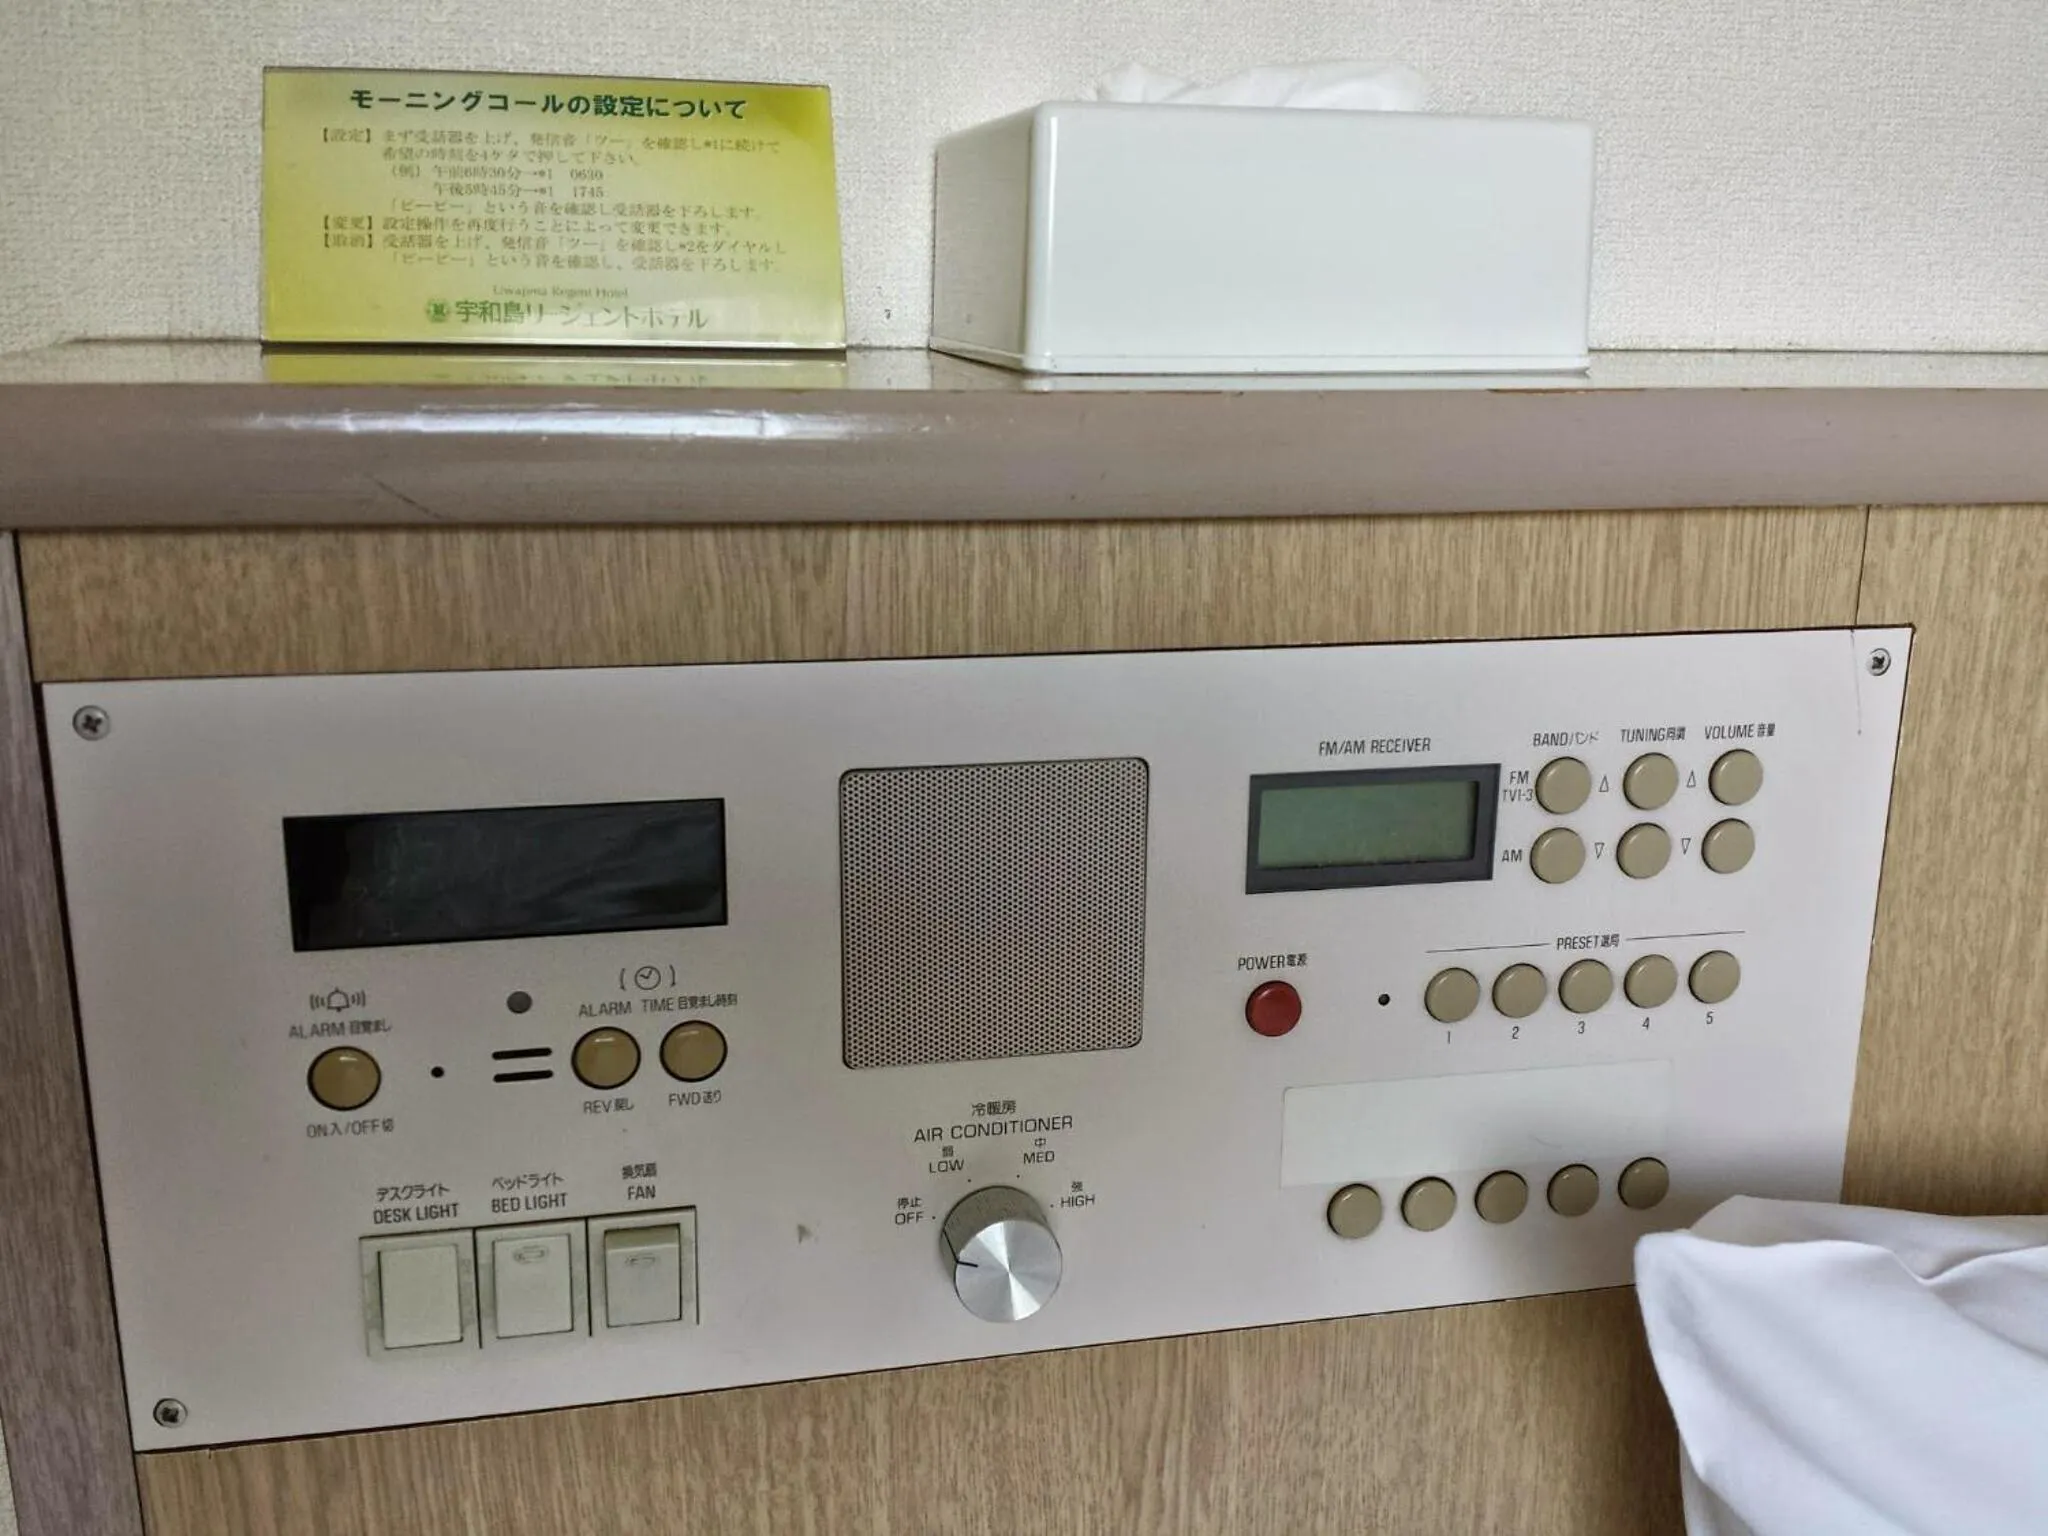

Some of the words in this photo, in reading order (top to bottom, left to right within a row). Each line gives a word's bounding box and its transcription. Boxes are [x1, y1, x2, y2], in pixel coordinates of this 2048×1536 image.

[350, 89, 747, 119] モーニングコールの設定について
[1704, 723, 1754, 740] VOLUME
[1319, 739, 1365, 757] FM/AM
[1370, 737, 1431, 754] RECEIVER
[1509, 770, 1529, 785] FM
[1501, 849, 1522, 863] AM
[578, 1000, 632, 1018] ALARM
[641, 996, 674, 1013] TIME
[1641, 1016, 1650, 1030] 4
[1705, 1011, 1714, 1025] 5
[288, 1021, 346, 1040] ALARM
[1511, 1026, 1520, 1040] 2
[1577, 1021, 1585, 1034] 3
[971, 1100, 1017, 1117] 冷暖房
[914, 1127, 943, 1143] AIR
[951, 1115, 1073, 1140] CONDITIONER
[1023, 1150, 1055, 1164] MED
[928, 1159, 964, 1174] LOW
[376, 1183, 450, 1202] デスクライト
[627, 1184, 657, 1201] FAN
[1060, 1194, 1096, 1208] HIGH
[491, 1196, 521, 1214] BED
[525, 1192, 568, 1210] LIGHT
[373, 1208, 411, 1225] DESK
[416, 1203, 460, 1219] LIGHT
[894, 1211, 924, 1226] OFF
